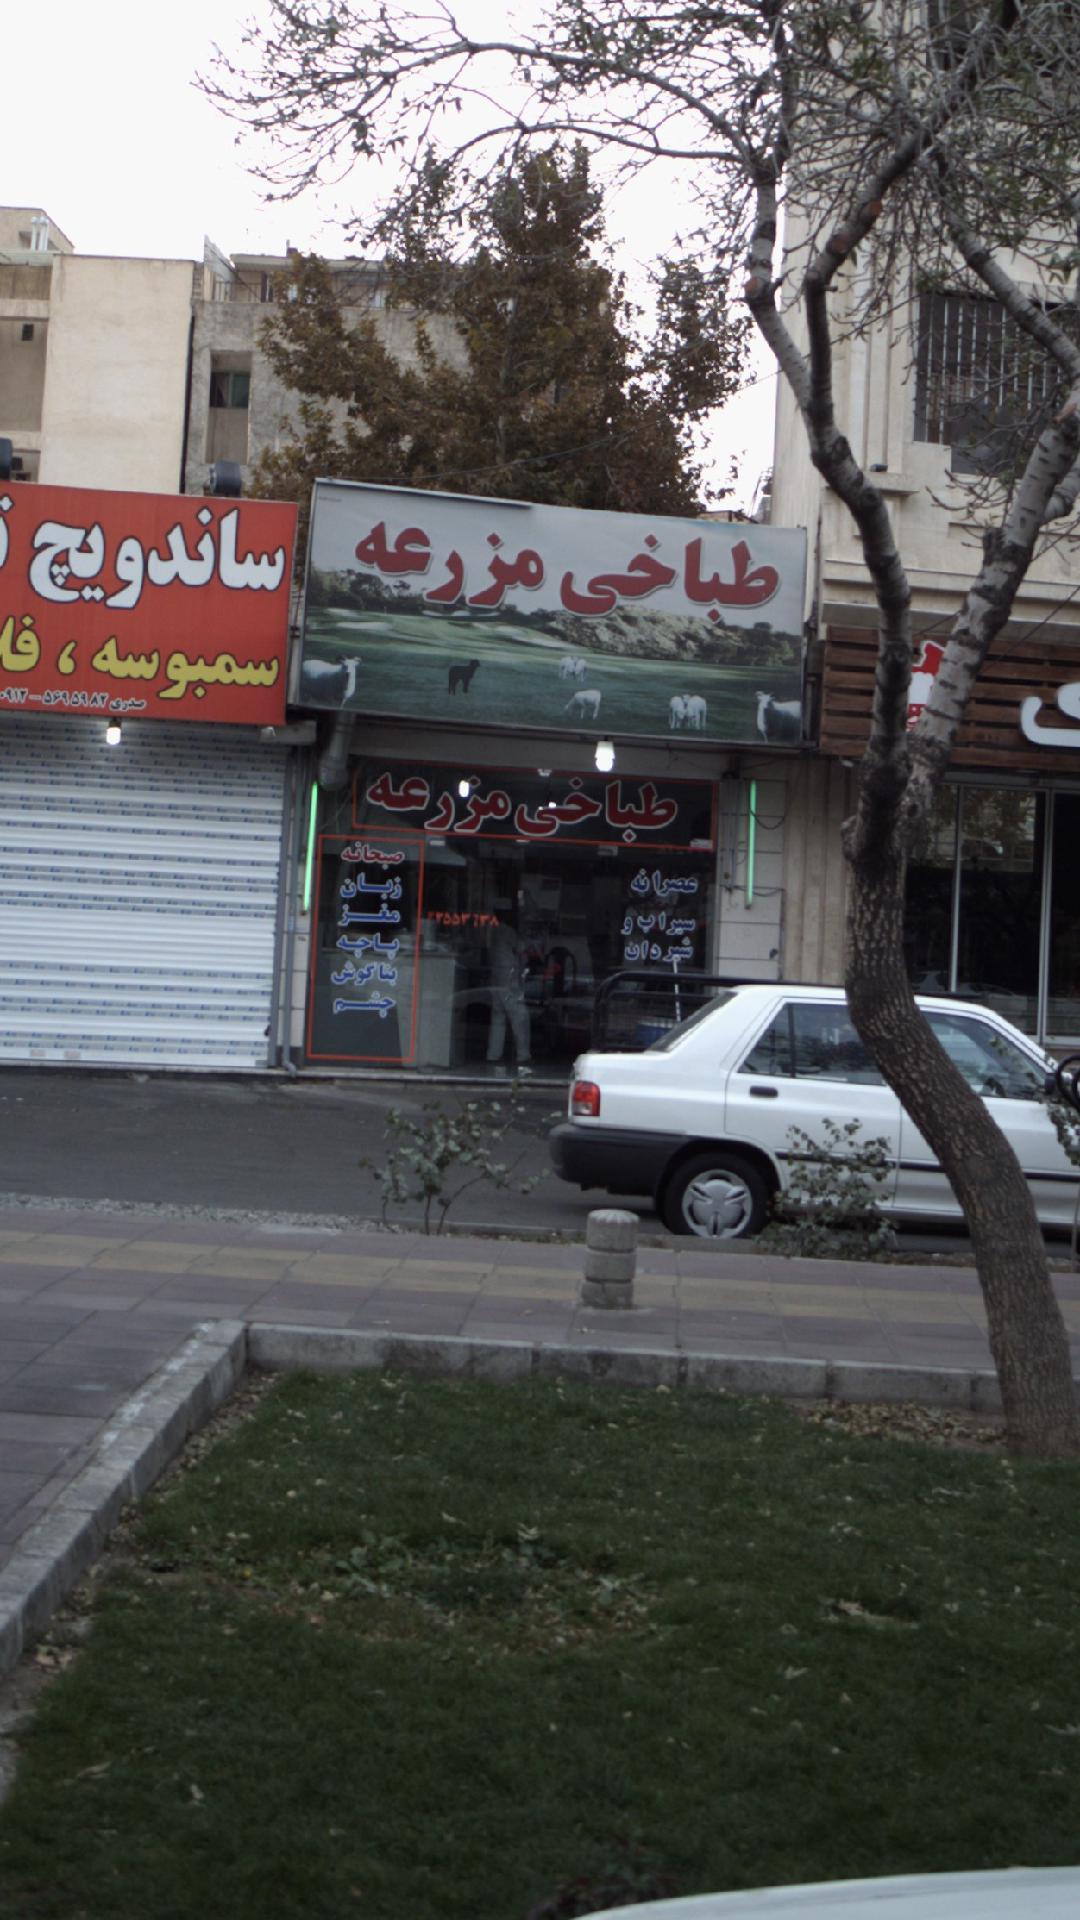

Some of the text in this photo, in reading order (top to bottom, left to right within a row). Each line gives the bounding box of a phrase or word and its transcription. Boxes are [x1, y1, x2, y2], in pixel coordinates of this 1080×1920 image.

[28, 506, 286, 610] ساندویچ
[353, 521, 781, 624] طباخی مزرعه
[91, 635, 280, 700] سمبوسه
[367, 772, 678, 842] طباخی مزرعه
[341, 841, 405, 870] صبحانه
[339, 872, 402, 899] زبان
[631, 868, 698, 897] عصرانه
[338, 903, 401, 926] مغز
[336, 932, 400, 960] پاچه
[333, 991, 396, 1018] چشم
